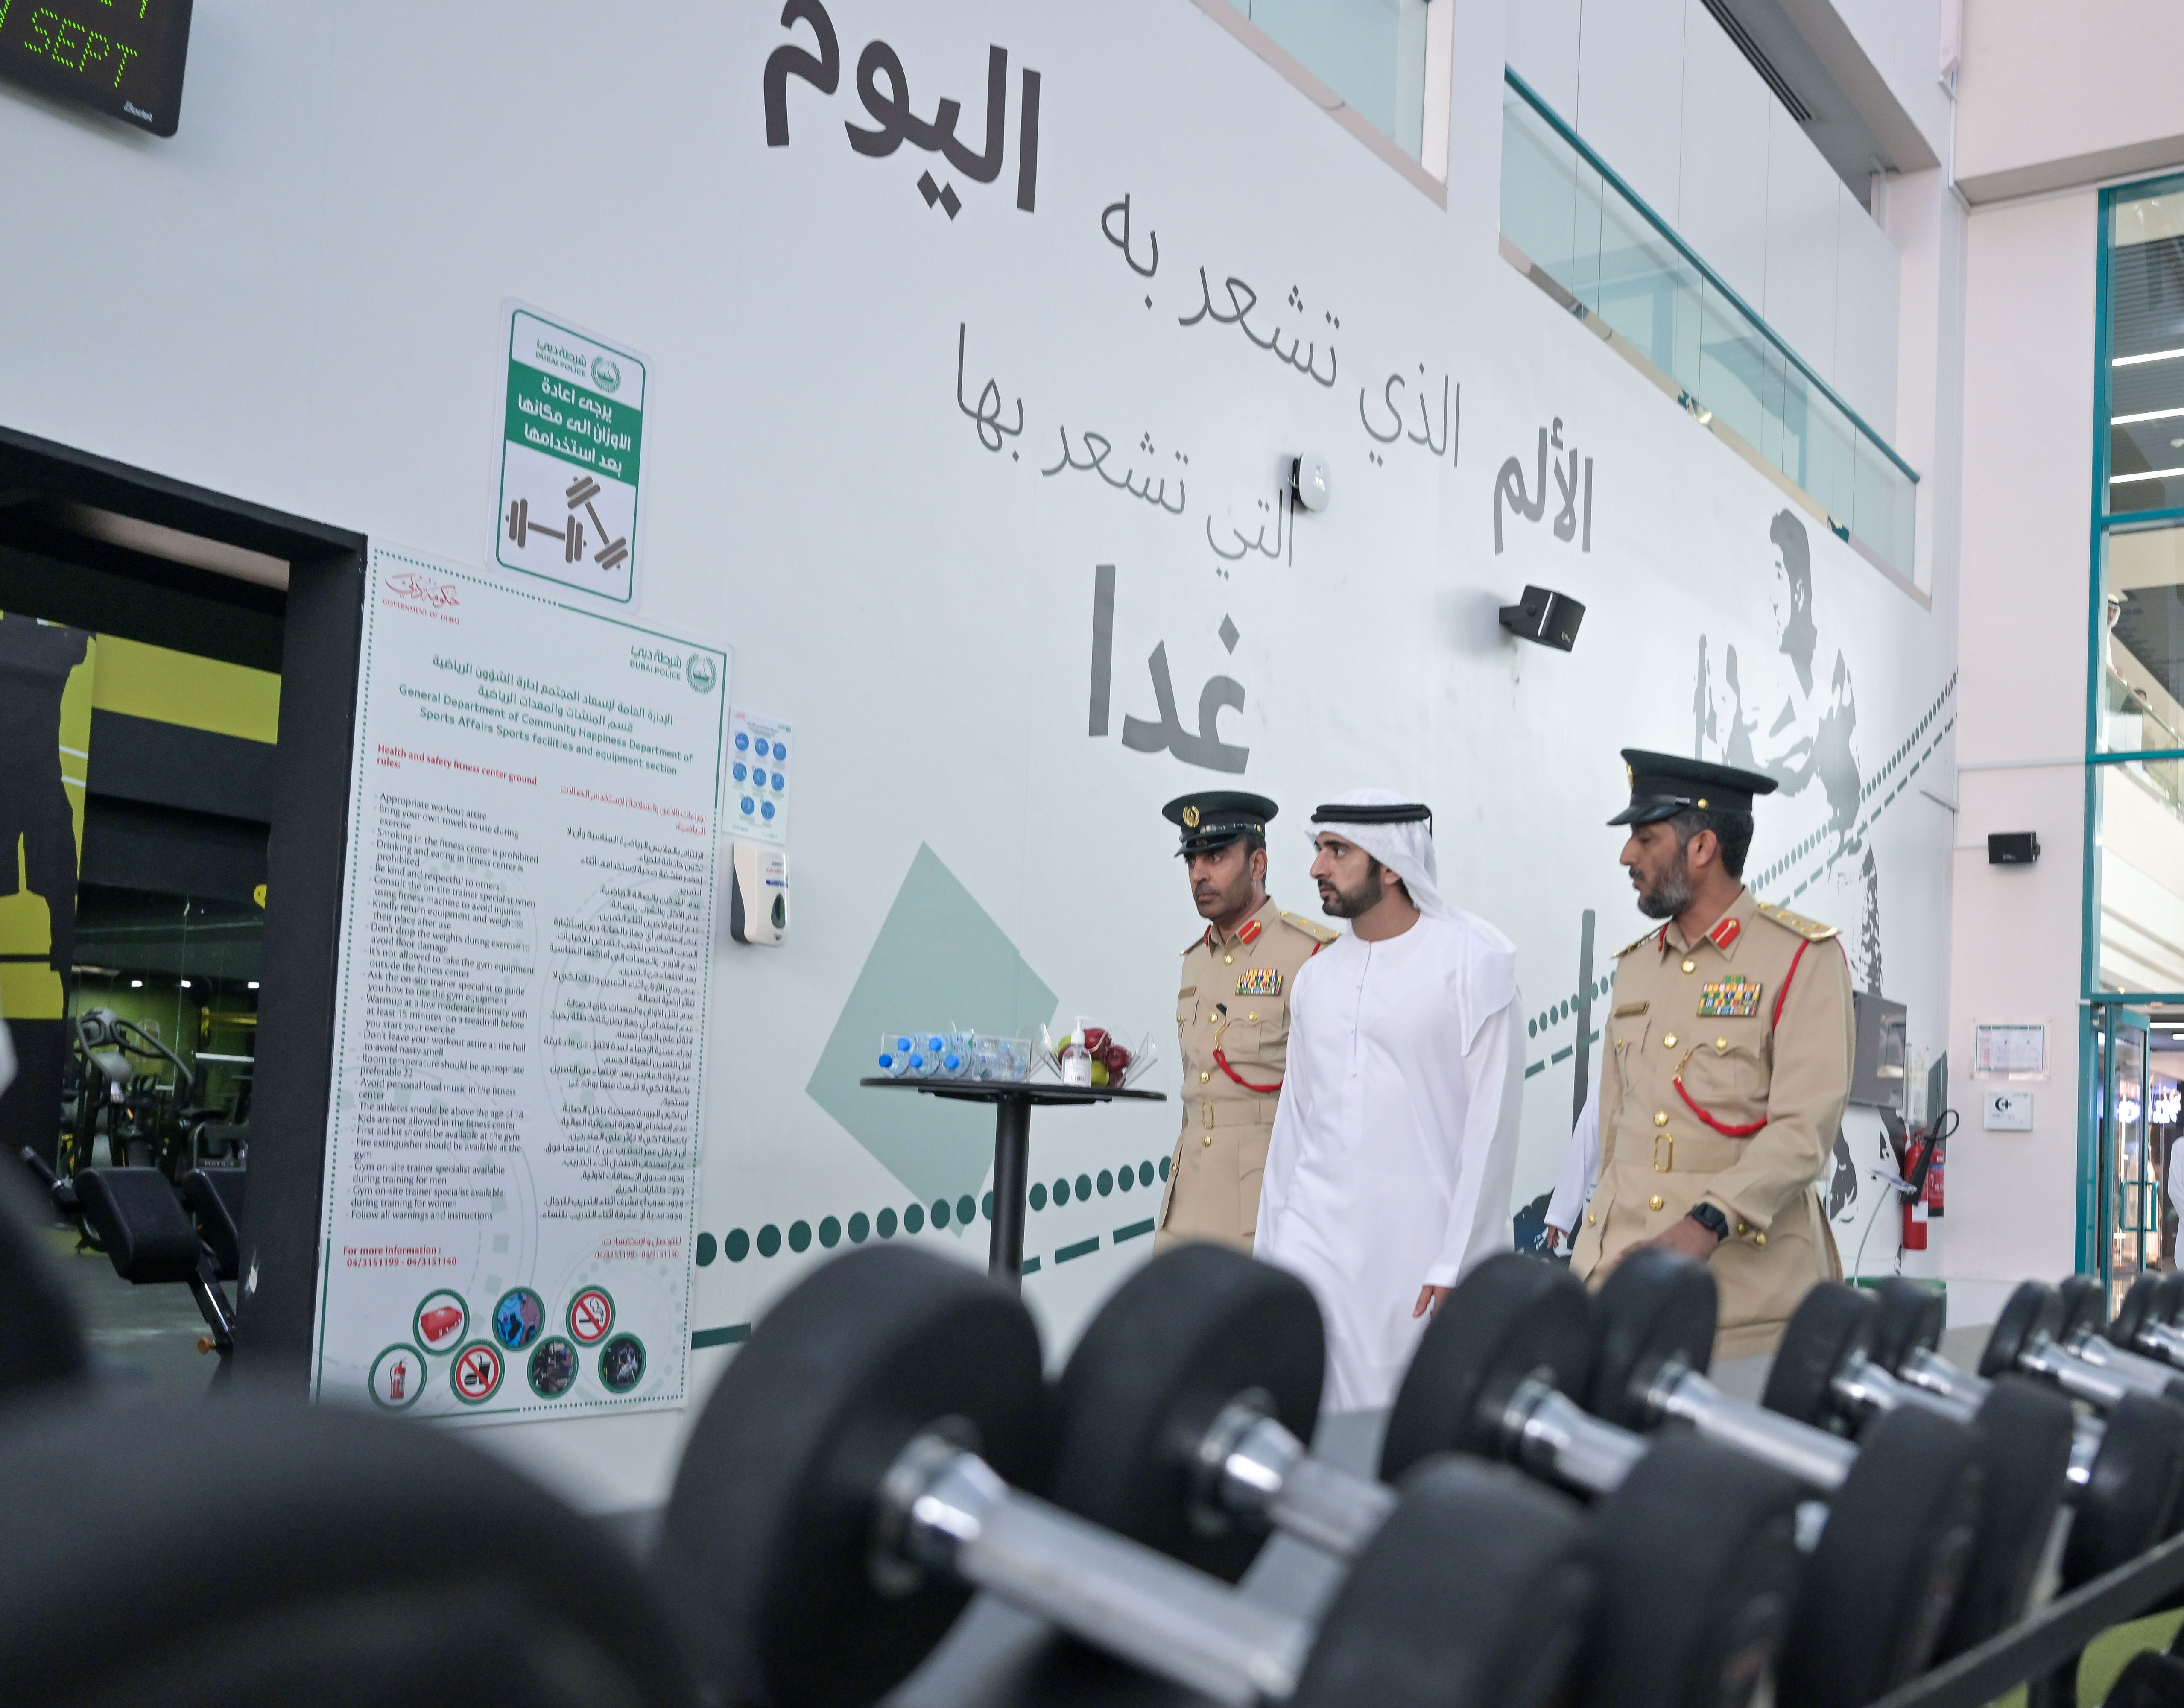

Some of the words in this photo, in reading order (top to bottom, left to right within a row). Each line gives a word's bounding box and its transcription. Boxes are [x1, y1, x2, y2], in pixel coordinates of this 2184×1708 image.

[24, 7, 138, 88] SEPT
[763, 0, 1041, 222] اليوم
[1101, 193, 1158, 310] به
[1178, 266, 1340, 387] تشعر
[537, 339, 558, 356] دبي
[559, 347, 587, 368] شرطة
[536, 351, 558, 367] DUBAI
[560, 361, 585, 377] POLICE
[541, 375, 575, 405] اعادة
[957, 322, 1023, 462] بها
[518, 393, 563, 425] مكانها
[578, 397, 612, 424] يرجى
[1360, 362, 1460, 468] الذي
[566, 418, 591, 437] الى
[594, 422, 631, 452] الاوزان
[524, 421, 596, 464] استخدامها
[598, 454, 622, 478] بعد
[1041, 425, 1188, 514] تشعر
[1494, 417, 1593, 555] الألم
[1207, 487, 1296, 580] التي
[383, 599, 428, 616] GOVERNMENT
[441, 614, 459, 626] DUBAI
[433, 655, 473, 675] الرياضية
[631, 646, 653, 662] دبي
[654, 649, 682, 669] شرطة
[630, 659, 653, 673] DUBAI
[655, 666, 681, 680] POLICE
[1089, 564, 1249, 774] غدا
[478, 685, 516, 705] الرياضية
[519, 696, 563, 717] والمعدات
[541, 685, 580, 702] المجتمع
[617, 702, 645, 718] العامة
[399, 684, 440, 704] General
[444, 694, 505, 719] Department
[508, 711, 519, 723] of
[522, 714, 576, 737] Community
[579, 726, 626, 748] Happiness
[629, 739, 681, 761] Department
[684, 753, 693, 763] of
[607, 721, 633, 733] قسم
[420, 706, 455, 724] Sports
[458, 716, 493, 733] Affairs
[497, 725, 529, 741] Sports
[532, 733, 573, 752] facilities
[576, 745, 593, 756] and
[595, 750, 643, 767] equipment
[646, 761, 677, 776] section
[377, 757, 400, 769] rules:
[378, 743, 406, 758] Health
[409, 752, 424, 762] and
[427, 756, 451, 769] safety
[453, 760, 479, 773] fitness
[482, 768, 507, 779] center
[509, 774, 537, 786] ground
[560, 786, 590, 799] الصالات
[380, 791, 429, 810] Appropriate
[431, 803, 463, 816] workout
[466, 810, 486, 821] attire
[379, 803, 400, 818] Bring
[402, 810, 421, 820] your
[423, 814, 440, 824] own
[442, 817, 467, 828] towels
[469, 822, 477, 830] to
[479, 824, 492, 833] use
[494, 825, 518, 839] during
[380, 817, 411, 830] exercise
[377, 827, 412, 844] Smoking
[415, 835, 422, 844] in
[424, 835, 438, 846] the
[440, 838, 465, 851] fitness
[466, 846, 491, 856] center
[492, 847, 498, 857] is
[500, 850, 538, 864] prohibited
[377, 839, 412, 856] Drinking
[414, 846, 429, 857] and
[431, 850, 455, 863] eating
[457, 854, 464, 863] in
[466, 853, 491, 867] fitness
[492, 861, 516, 871] center
[518, 862, 523, 873] is
[377, 852, 420, 867] prohibited
[375, 862, 385, 873] Be
[387, 864, 405, 876] kind
[407, 869, 422, 879] and
[424, 873, 463, 886] respectful
[465, 878, 474, 887] to
[475, 879, 499, 891] others
[374, 875, 405, 889] Consult
[408, 879, 421, 890] the
[423, 883, 450, 895] on-site
[453, 888, 478, 899] trainer
[479, 893, 514, 906] specialist
[515, 897, 535, 908] when
[371, 921, 393, 934] Don't
[396, 925, 415, 939] drop
[417, 928, 430, 939] the
[433, 932, 462, 944] weights
[464, 934, 489, 948] during
[491, 940, 520, 951] exercise
[522, 944, 530, 952] to
[371, 936, 394, 946] avoid
[396, 936, 414, 949] floor
[417, 939, 448, 954] damage
[360, 1065, 401, 1077] preferable
[403, 1067, 413, 1078] 22
[362, 1053, 386, 1065] Room
[389, 1057, 439, 1069] temperature
[441, 1059, 467, 1070] should
[469, 1061, 479, 1071] be
[480, 1065, 524, 1076] appropriate
[360, 1101, 374, 1111] The
[376, 1102, 408, 1113] athletes
[410, 1104, 437, 1115] should
[439, 1105, 449, 1115] be
[451, 1106, 474, 1116] above
[476, 1107, 488, 1118] the
[490, 1110, 503, 1120] age
[505, 1109, 513, 1119] of
[516, 1110, 523, 1120] 18
[353, 1173, 380, 1186] during
[382, 1173, 414, 1186] training
[416, 1174, 427, 1184] for
[354, 1160, 374, 1174] Gym
[377, 1162, 405, 1172] on-site
[407, 1164, 433, 1173] trainer
[436, 1164, 469, 1176] specialist
[472, 1165, 505, 1175] available
[351, 1208, 379, 1219] Follow
[381, 1209, 390, 1220] all
[392, 1209, 428, 1221] warnings
[430, 1210, 445, 1220] and
[447, 1210, 493, 1220] instructions
[343, 1246, 358, 1255] For
[386, 1245, 436, 1255] information
[652, 1236, 681, 1247] للتواصل
